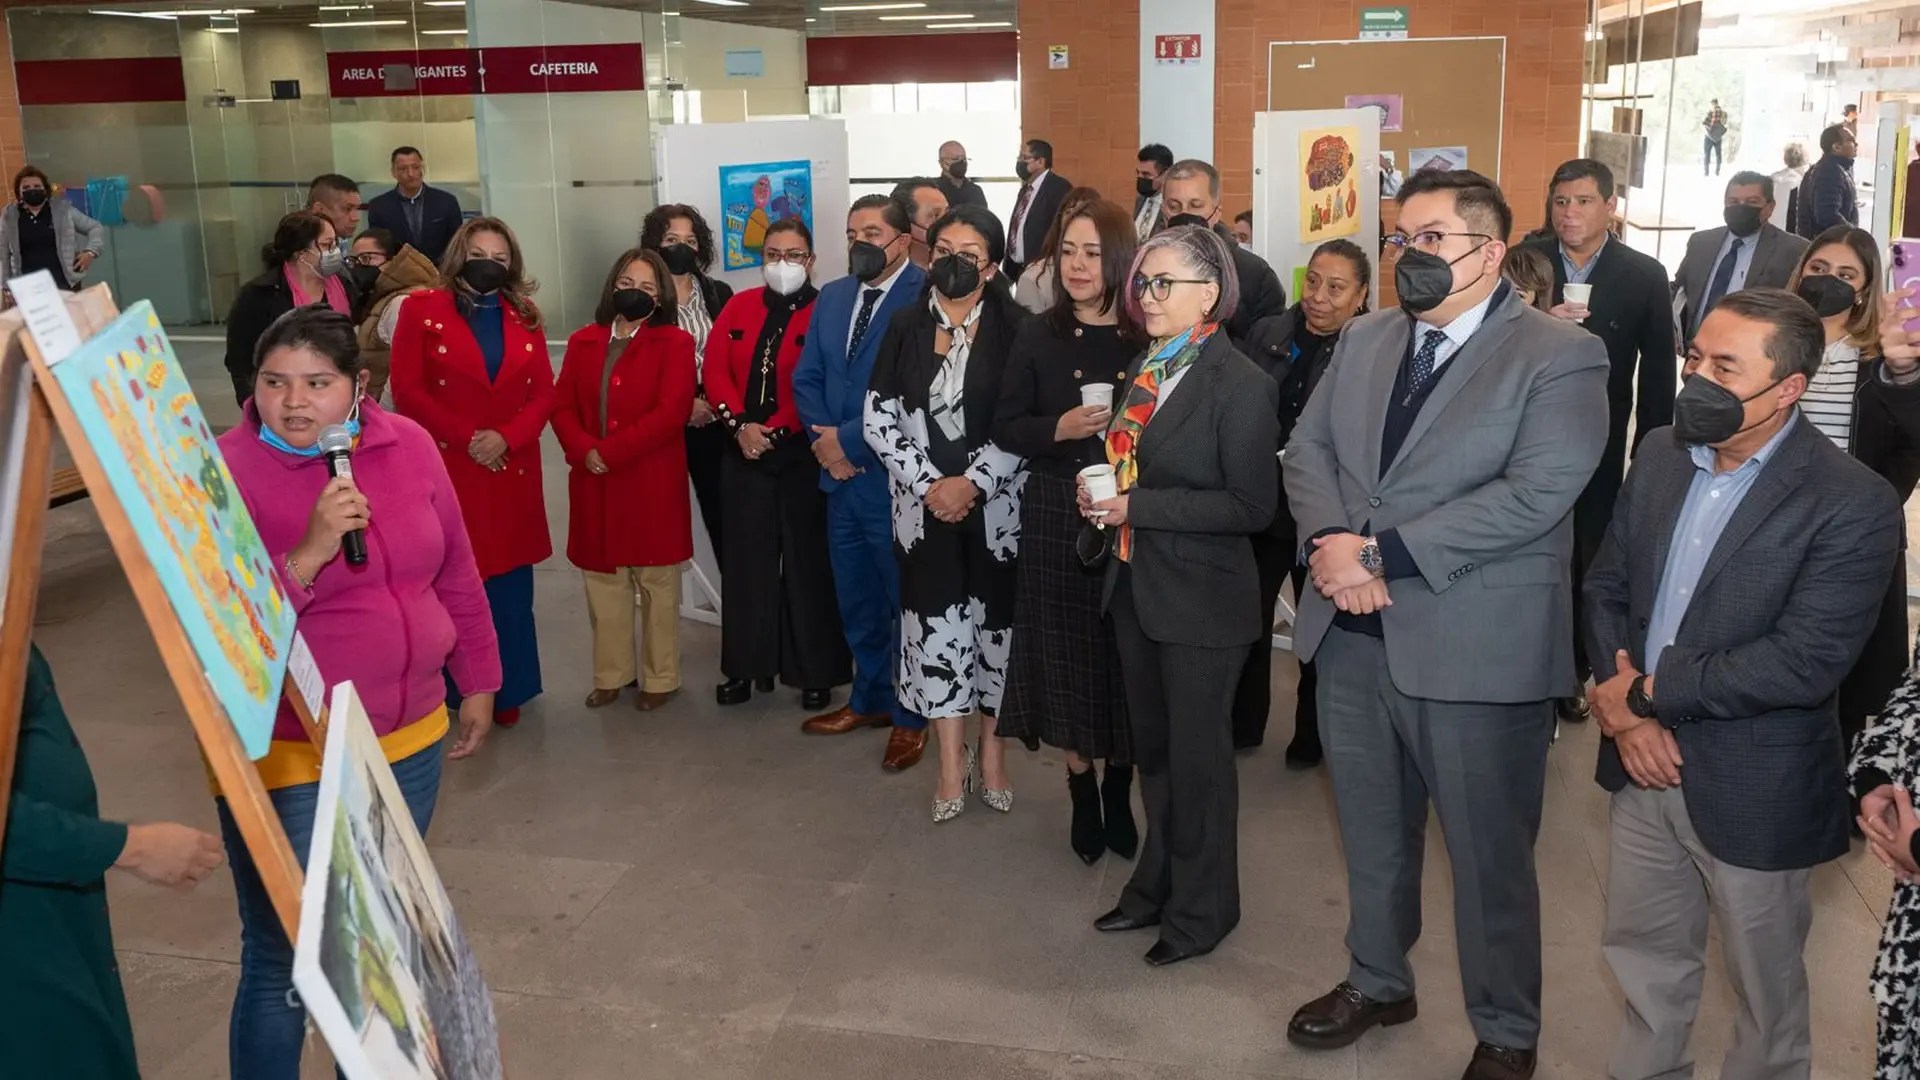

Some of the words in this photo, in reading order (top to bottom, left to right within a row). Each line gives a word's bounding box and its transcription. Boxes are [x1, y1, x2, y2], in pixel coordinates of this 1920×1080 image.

[342, 68, 376, 80] AREA
[414, 65, 467, 78] IGANTES
[529, 62, 599, 76] CAFETERIA
